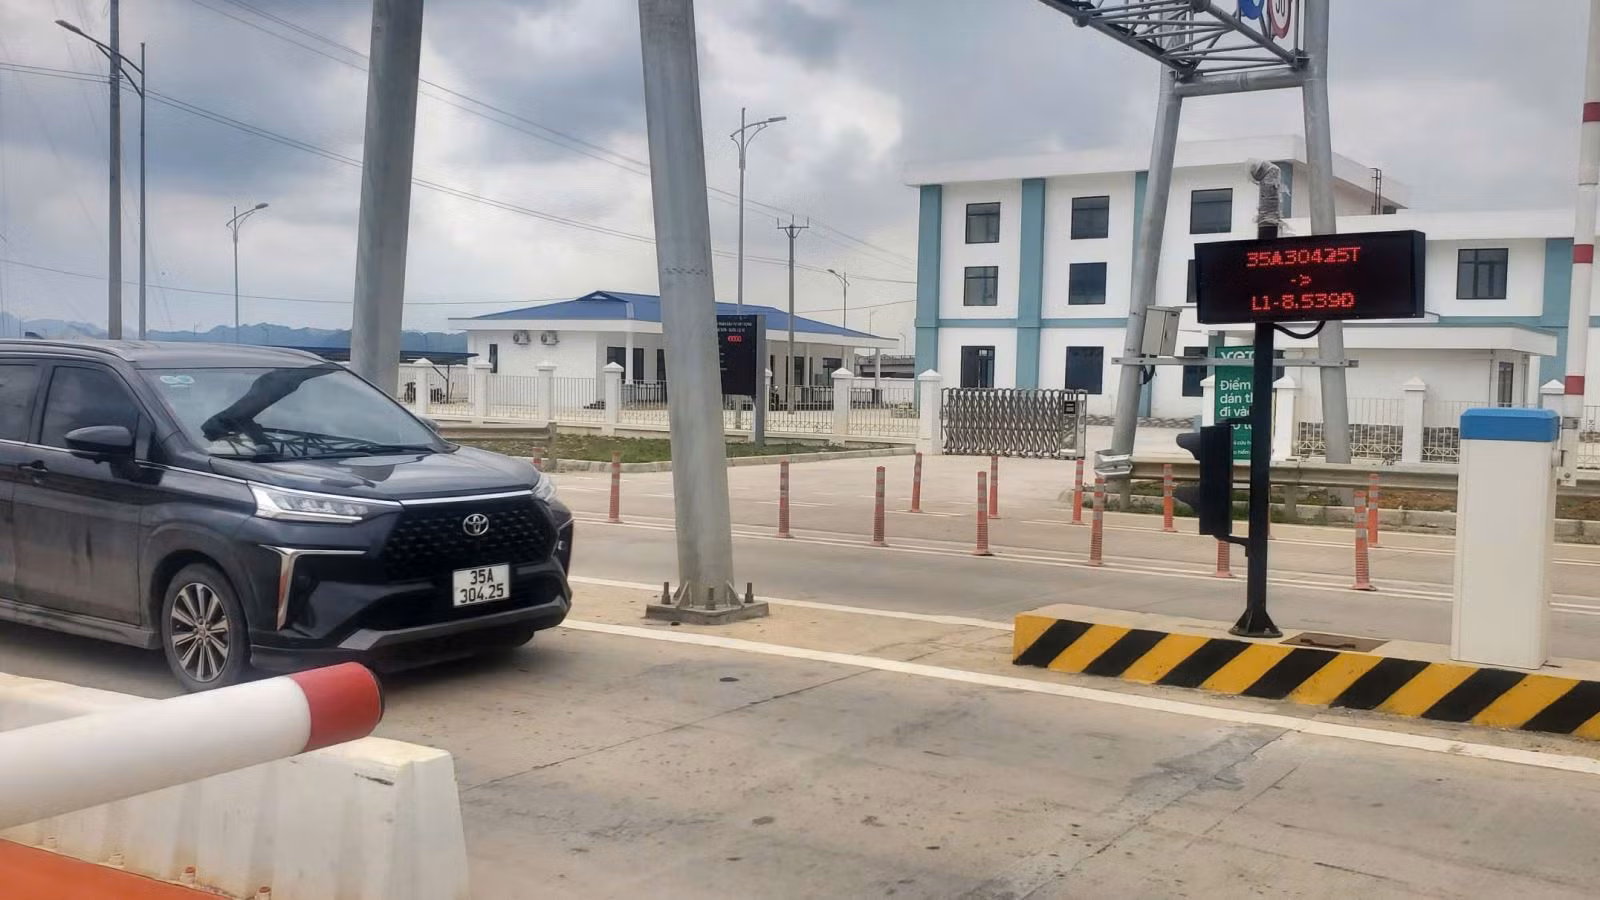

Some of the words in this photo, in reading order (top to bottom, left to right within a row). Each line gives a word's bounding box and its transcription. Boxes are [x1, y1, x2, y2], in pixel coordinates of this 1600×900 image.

[1247, 246, 1361, 267] 35A30425T
[1219, 392, 1242, 404] dán
[1219, 406, 1231, 417] đi
[470, 568, 494, 585] 35A
[460, 583, 504, 603] 304.25
